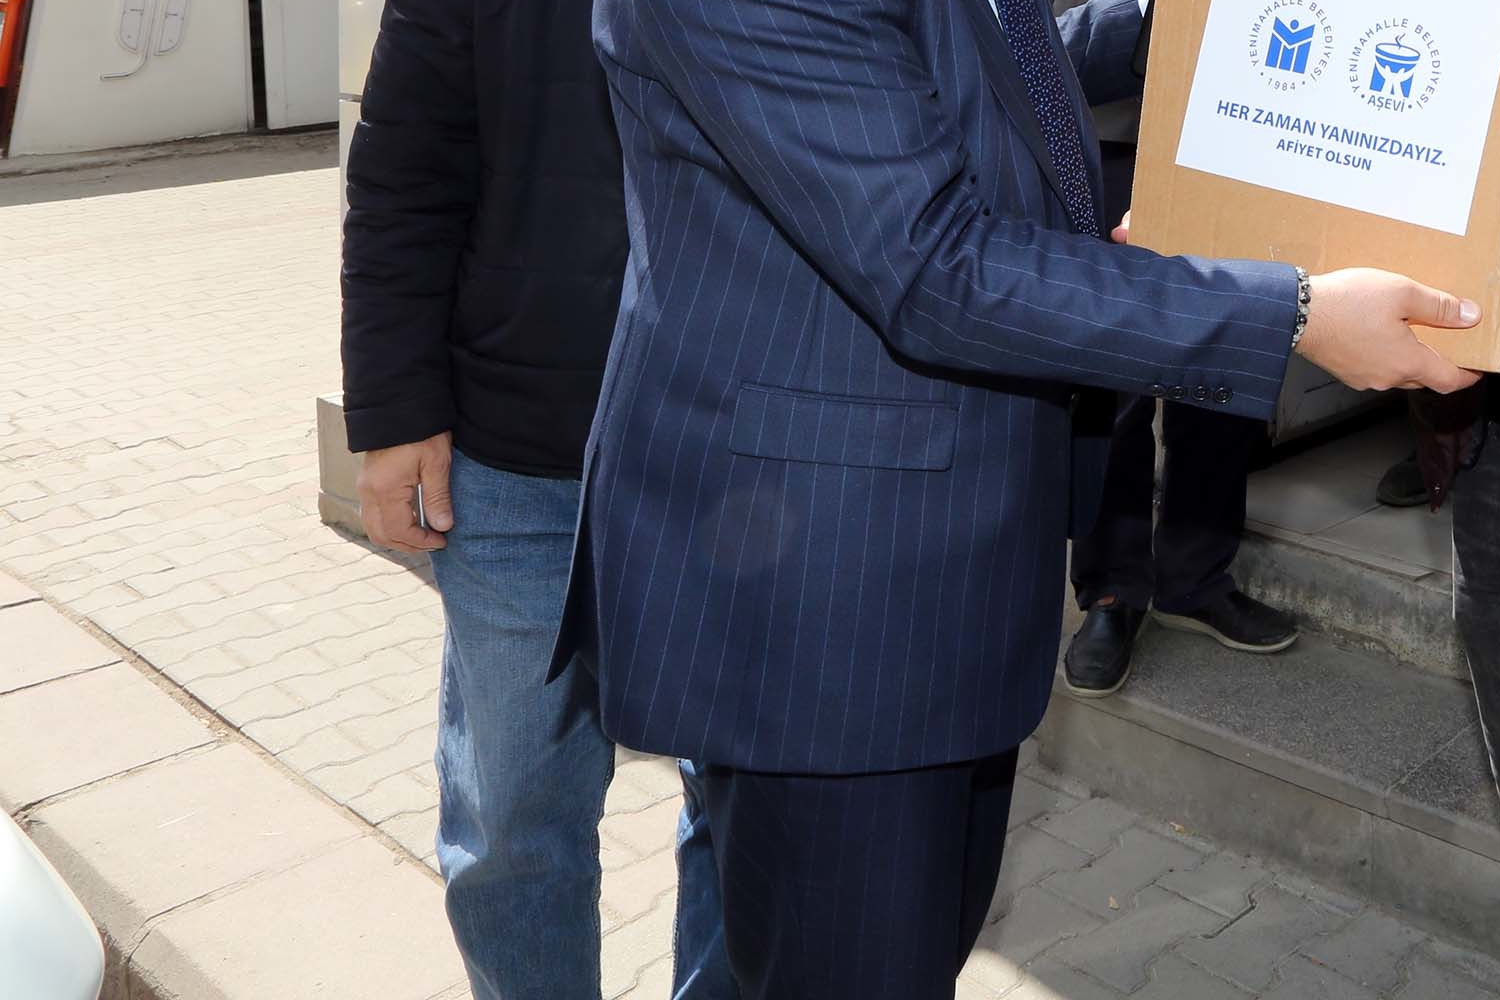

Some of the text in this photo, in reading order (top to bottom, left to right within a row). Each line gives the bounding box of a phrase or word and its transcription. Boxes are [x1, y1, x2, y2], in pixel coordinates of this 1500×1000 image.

[1308, 2, 1334, 82] BELEDİYESİ
[1347, 17, 1442, 110] YENİMAHALLE BELEDİYESİ
[1267, 77, 1296, 92] 1984
[1367, 94, 1406, 113] AŞEVİ
[1216, 99, 1447, 167] HER ZAMAN YANINIZDAYIZ.
[1275, 138, 1373, 172] AFİYET OLSUN
